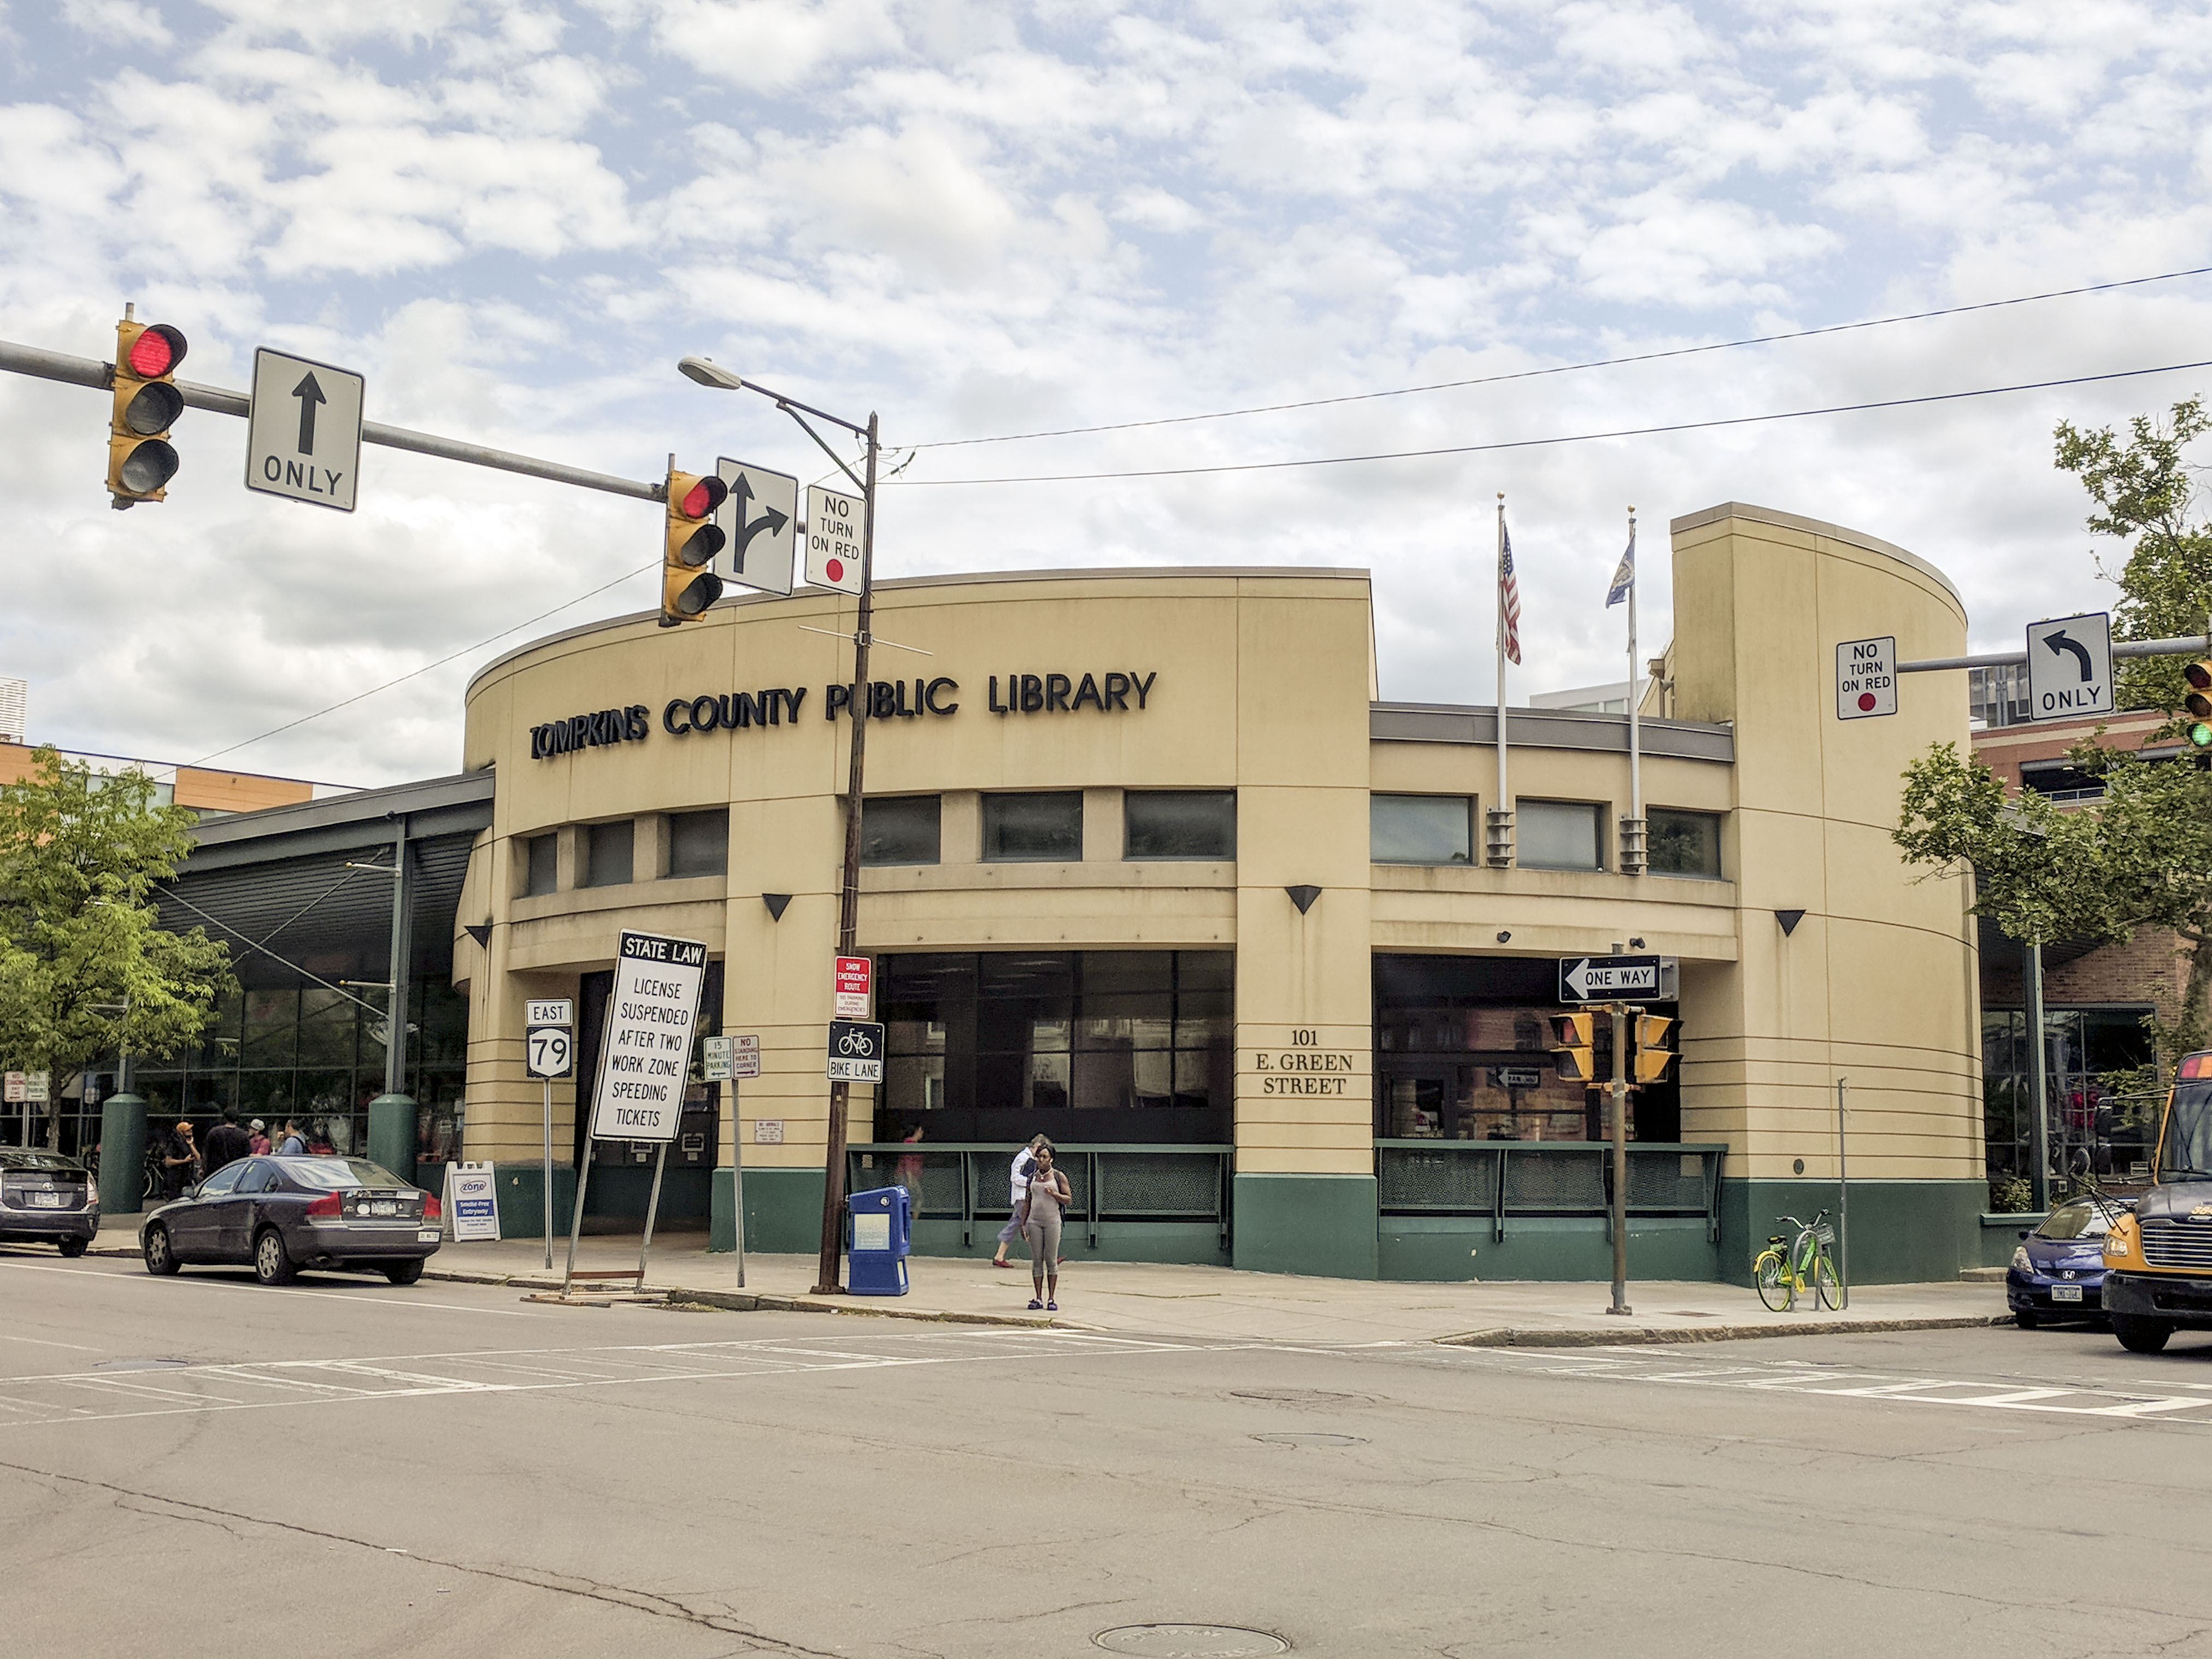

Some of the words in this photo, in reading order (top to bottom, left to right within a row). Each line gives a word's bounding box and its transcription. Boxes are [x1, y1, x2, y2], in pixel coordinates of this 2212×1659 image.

[264, 455, 342, 495] ONLY
[825, 495, 849, 517] NO
[820, 517, 852, 539] TURN
[812, 536, 828, 552] ON
[836, 541, 859, 560] RED
[1854, 644, 1877, 660] NO
[1849, 661, 1882, 676] TURN
[1842, 680, 1859, 692] ON
[1866, 676, 1891, 690] RED
[2043, 686, 2101, 710] ONLY
[530, 704, 650, 760] TOMPKINS
[663, 687, 807, 734] COUNTY
[989, 672, 1157, 713] LIBRARY
[625, 938, 667, 960] STATE
[672, 944, 703, 964] LAW
[1586, 971, 1612, 985] ONE
[1621, 970, 1650, 984] WAY
[634, 978, 682, 999] LICENSE
[533, 1006, 563, 1020] EAST
[621, 1002, 689, 1025] SUSPENDED
[618, 1029, 655, 1048] AFTER
[660, 1033, 682, 1051] TWO
[714, 1041, 722, 1049] 15
[740, 1038, 751, 1046] NO
[1291, 1029, 1317, 1046] 101
[531, 1038, 567, 1066] 79
[708, 1050, 730, 1060] MINUTE
[612, 1055, 644, 1073] WORK
[648, 1058, 679, 1076] ZONE
[831, 1062, 850, 1076] BIKE
[855, 1063, 879, 1078] LANE
[1256, 1054, 1274, 1070] E.
[1280, 1054, 1353, 1071] GREEN
[612, 1081, 668, 1101] SPEEDING
[1263, 1077, 1346, 1095] STREET
[617, 1109, 661, 1127] TICKETS
